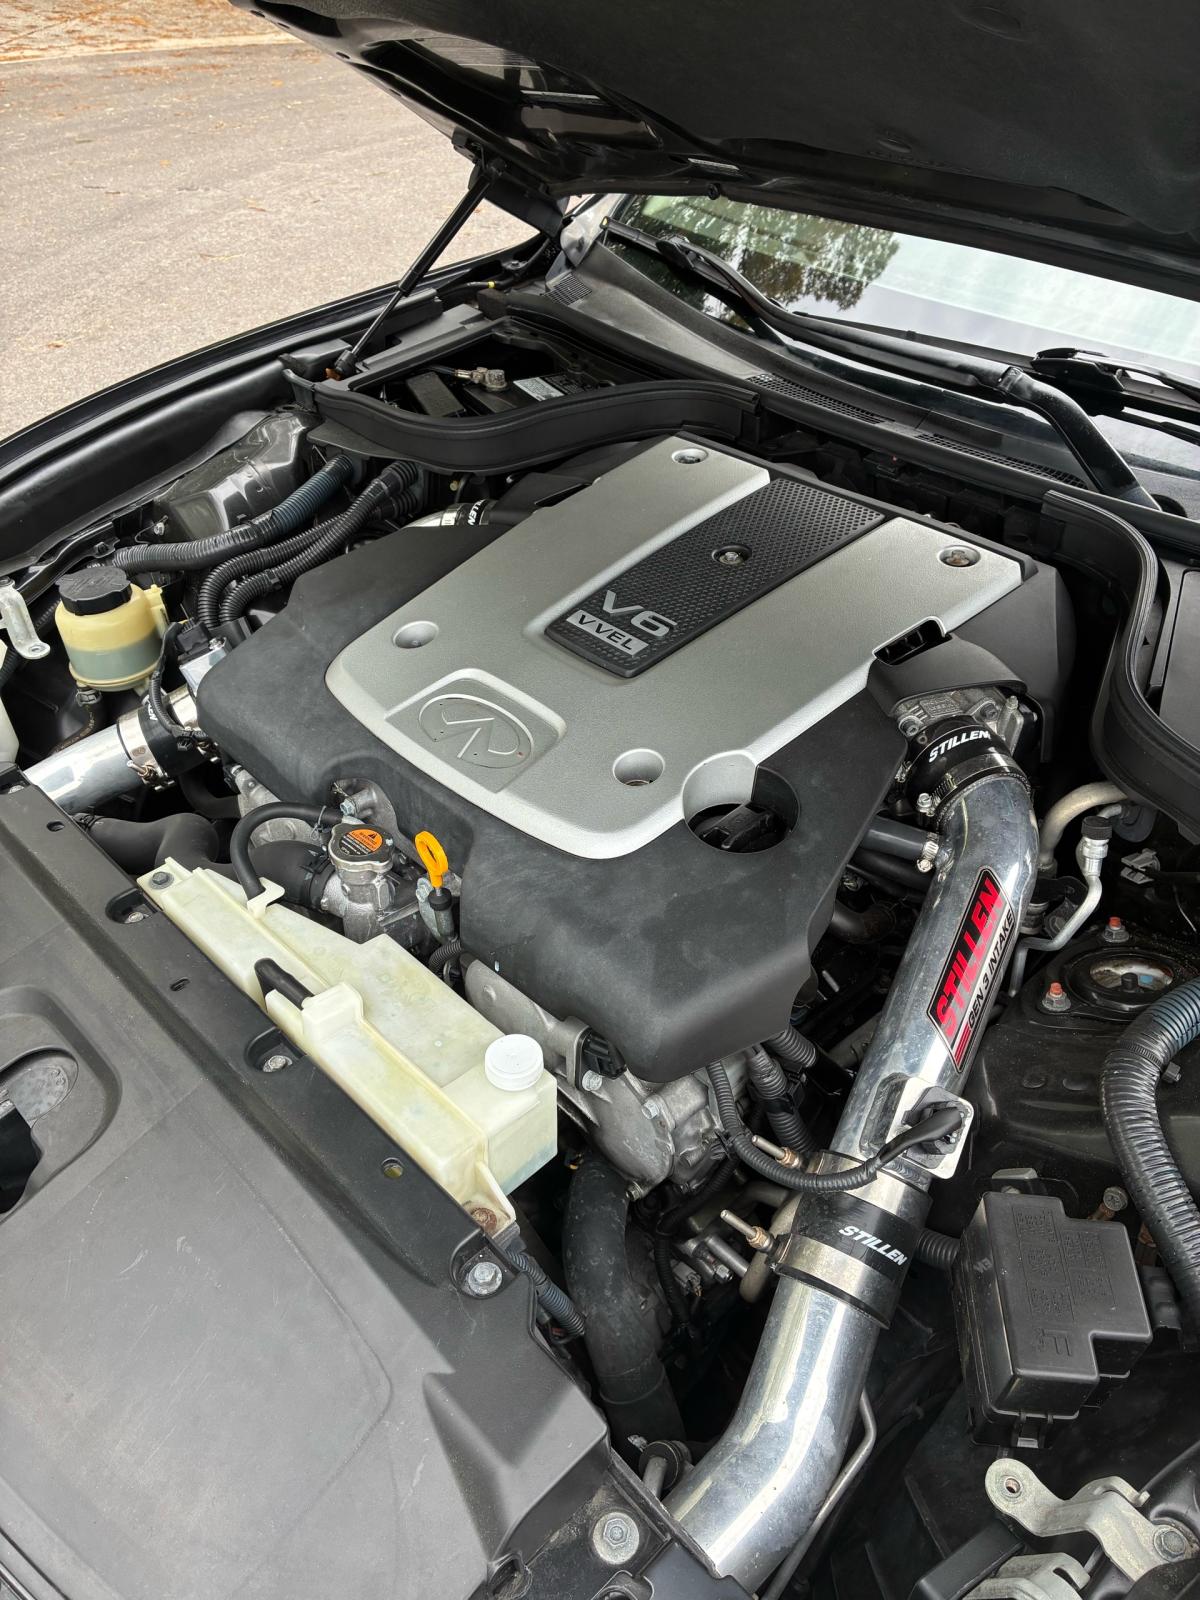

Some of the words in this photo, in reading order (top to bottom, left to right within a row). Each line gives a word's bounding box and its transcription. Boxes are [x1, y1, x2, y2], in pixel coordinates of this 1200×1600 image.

[578, 614, 633, 651] VVEL
[603, 590, 678, 637] V6
[928, 730, 992, 763] STILLEN
[936, 877, 1004, 1038] STILLEN
[968, 988, 985, 1031] GEN
[982, 973, 990, 986] 3
[988, 909, 1014, 973] INTAKE
[838, 1225, 908, 1266] STILLEN
